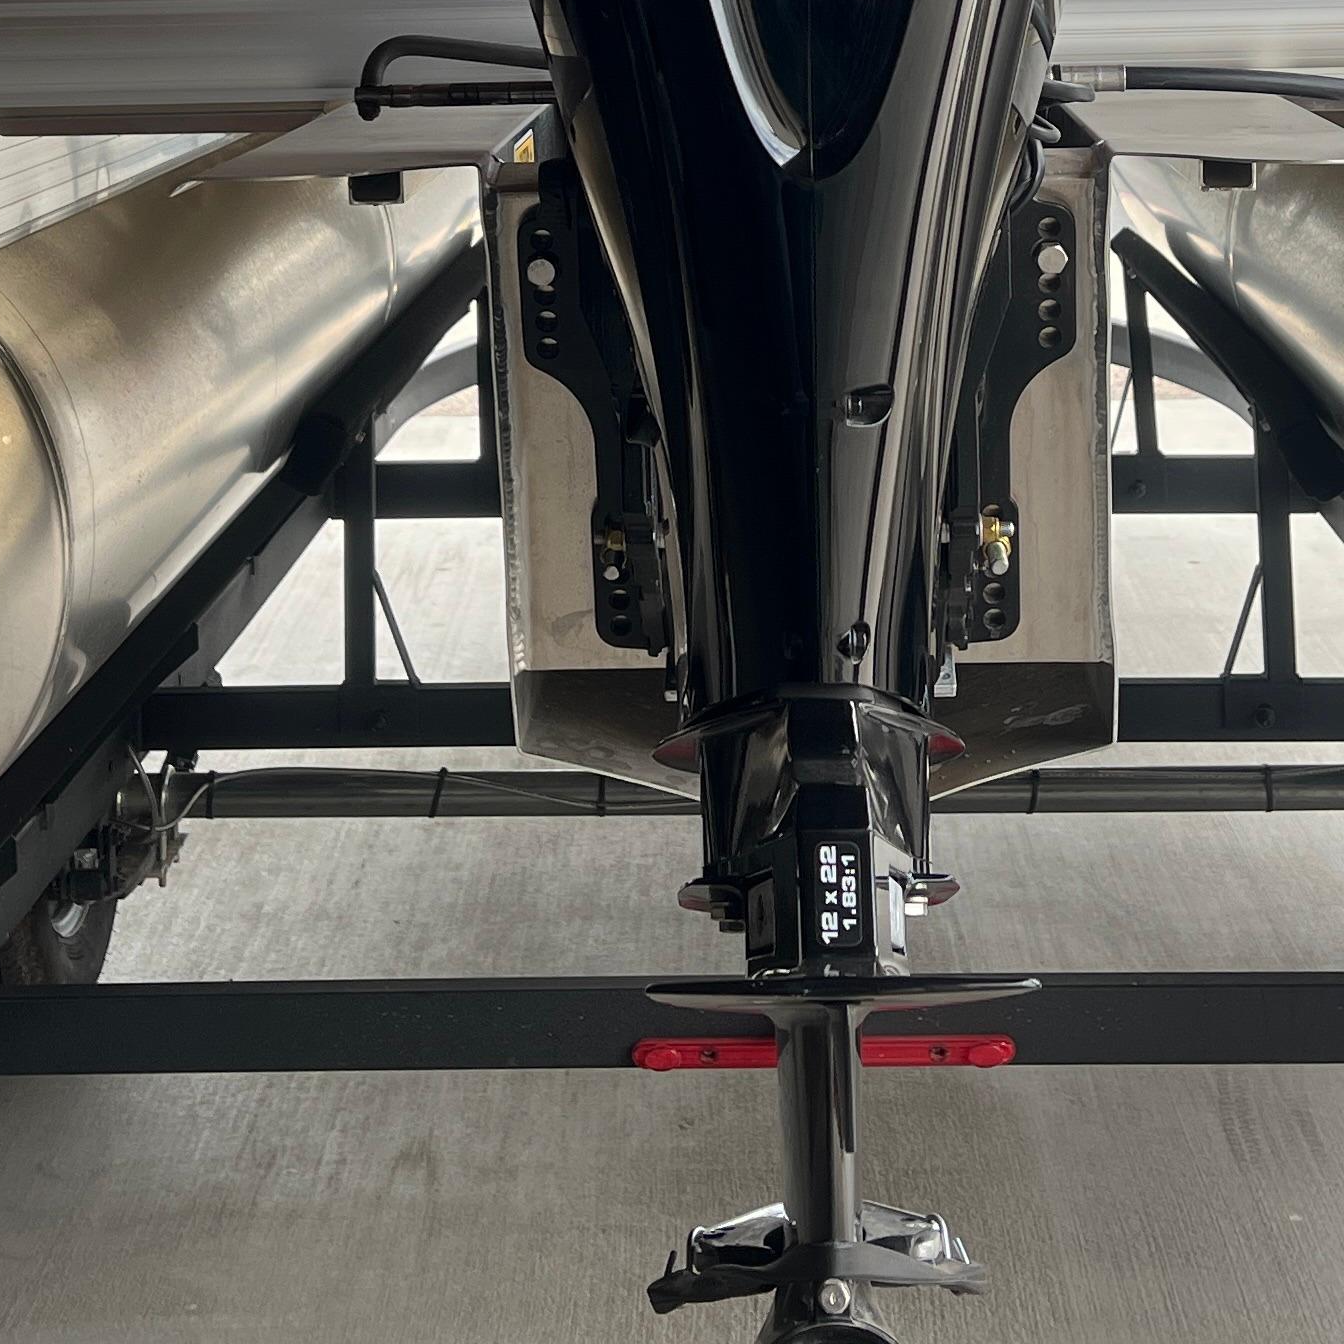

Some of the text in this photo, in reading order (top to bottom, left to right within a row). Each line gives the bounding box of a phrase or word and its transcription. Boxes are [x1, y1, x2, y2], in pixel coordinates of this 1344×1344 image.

[819, 845, 839, 945] 12 x 22
[841, 854, 857, 931] 1.83:1
